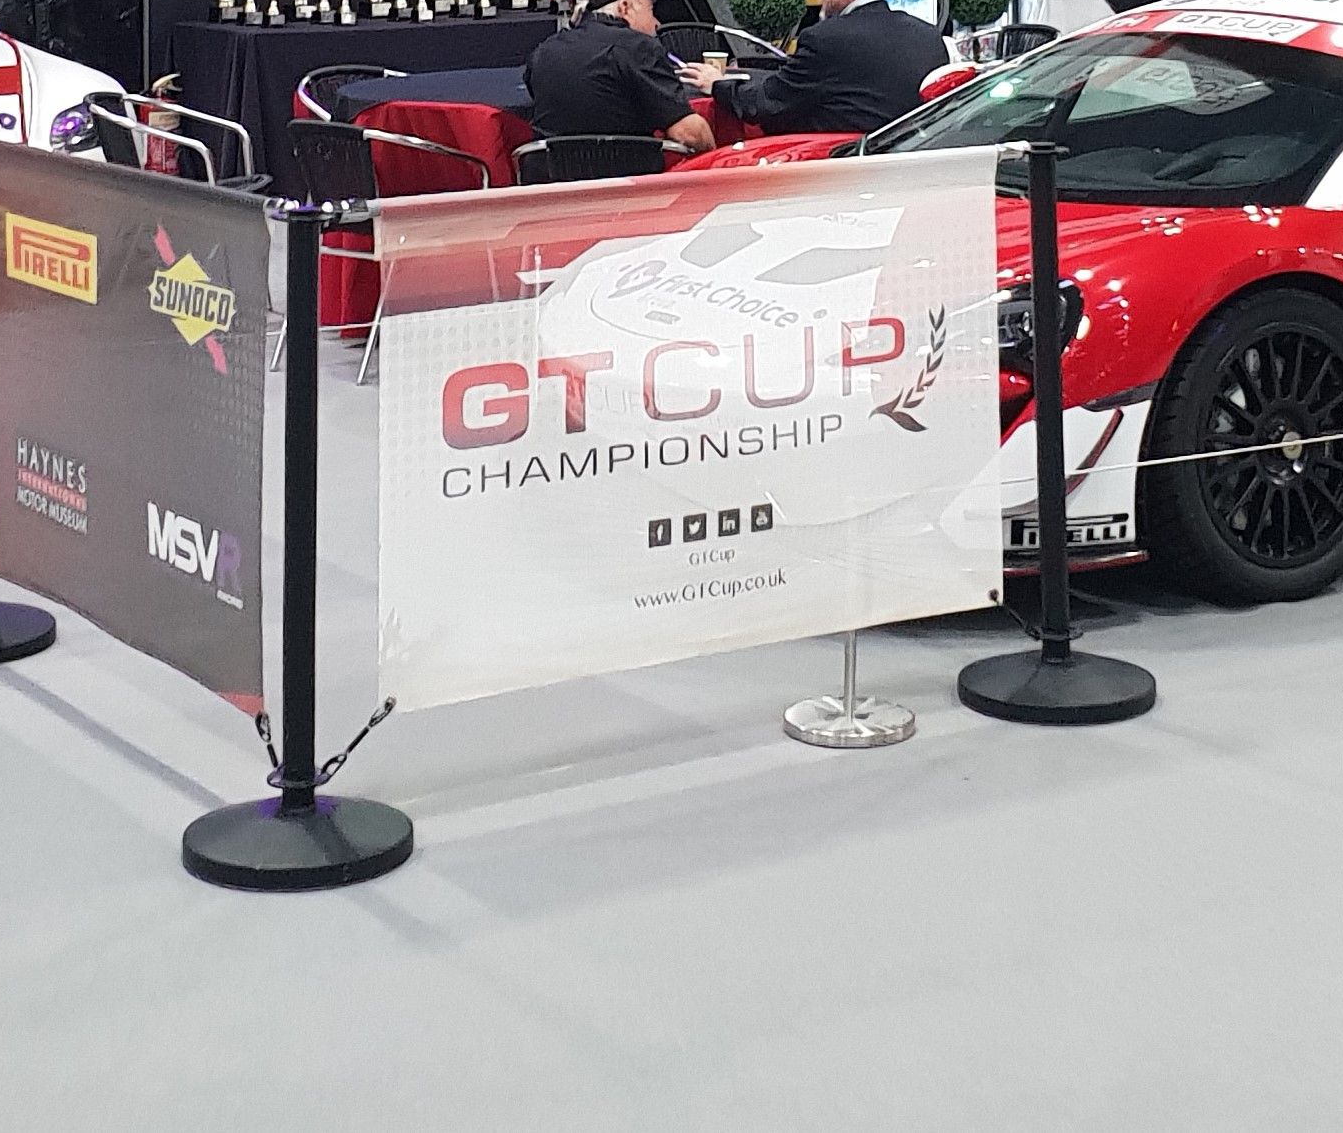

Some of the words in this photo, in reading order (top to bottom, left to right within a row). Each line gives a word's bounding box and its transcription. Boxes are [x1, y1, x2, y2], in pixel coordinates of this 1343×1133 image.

[1216, 15, 1294, 37] CUP
[13, 225, 91, 291] PIRELLI
[153, 275, 234, 327] SUNOCO
[707, 284, 800, 328] Choice
[441, 349, 615, 452] GT
[643, 316, 907, 423] CUP
[17, 436, 87, 494] HAYNES
[441, 413, 844, 499] CHAMPIONSHIP
[15, 485, 48, 516] MOTOR
[48, 500, 89, 536] MUSEUM
[1010, 512, 1130, 546] PIELLI
[688, 547, 735, 566] GTCup
[633, 568, 788, 611] www.GTCup.co.uk
